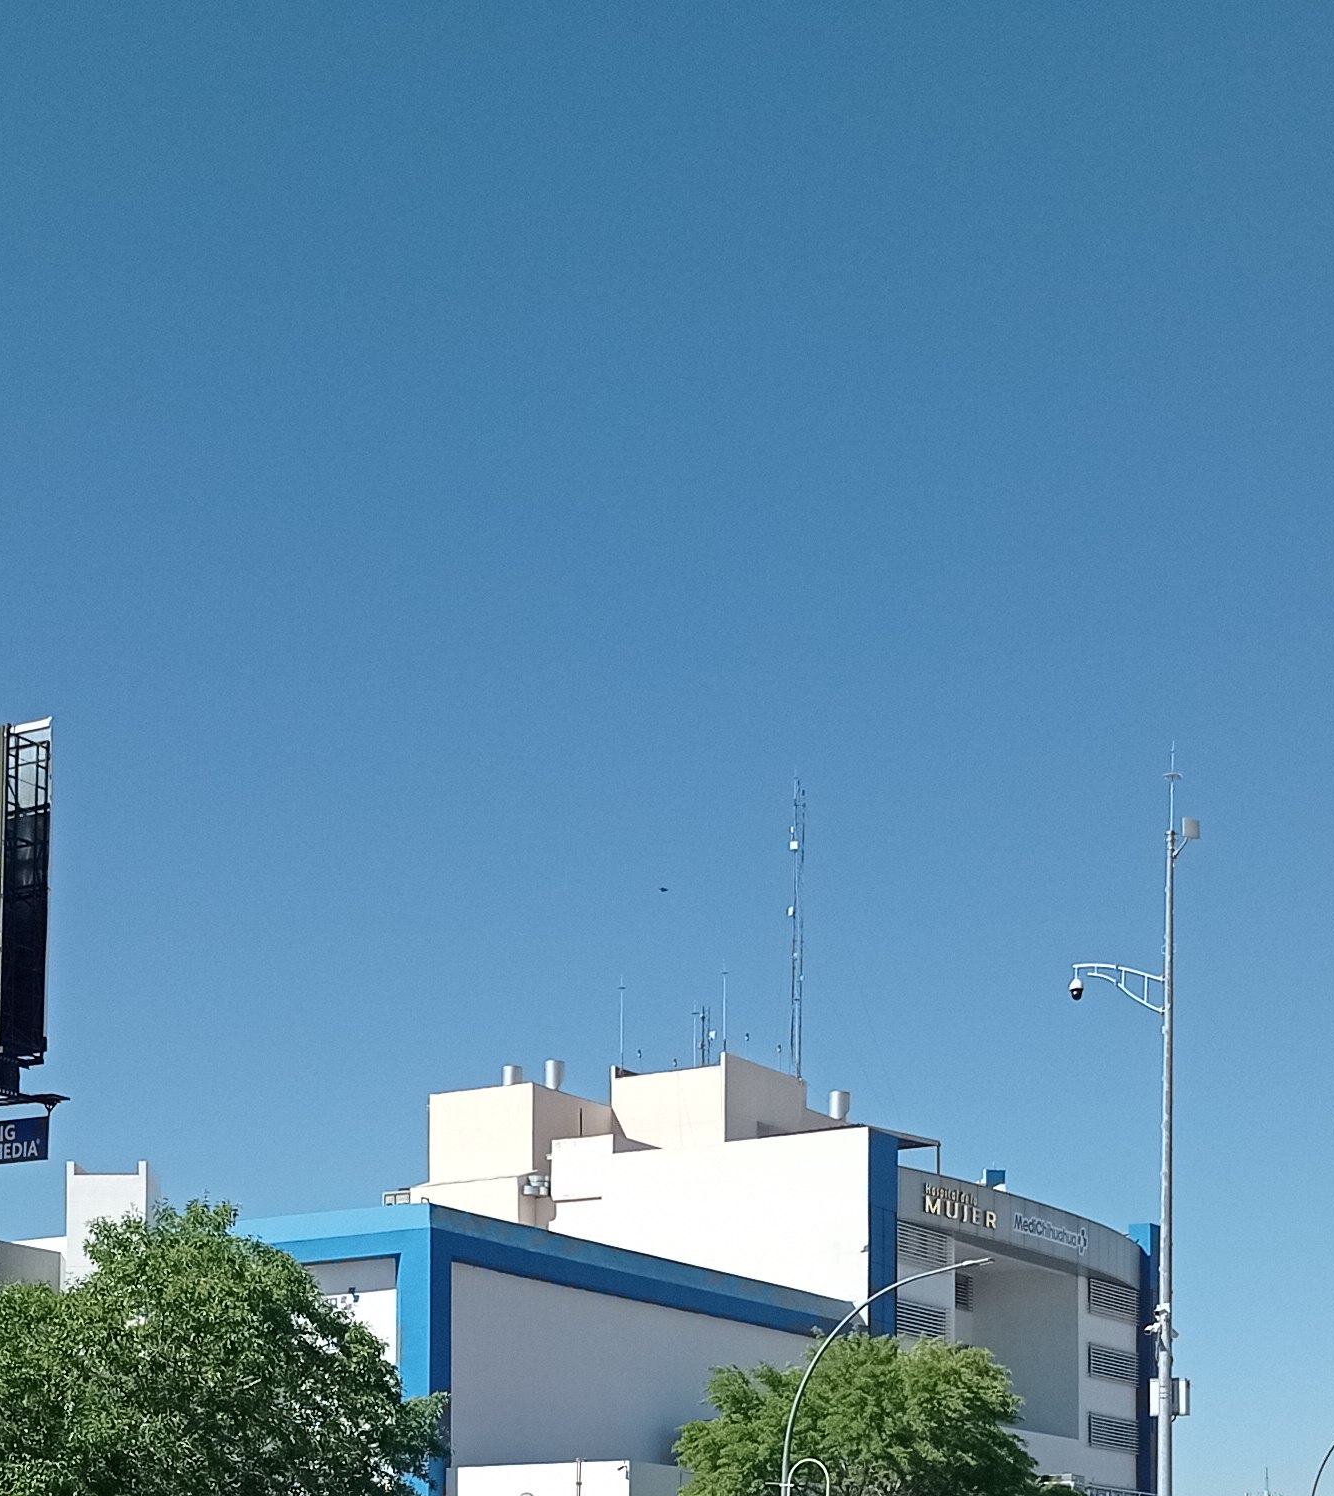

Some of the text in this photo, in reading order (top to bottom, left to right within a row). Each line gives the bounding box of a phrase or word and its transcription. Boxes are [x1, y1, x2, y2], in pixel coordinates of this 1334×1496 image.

[925, 1182, 960, 1202] Hospital
[925, 1195, 997, 1230] MUJER
[1014, 1214, 1076, 1246] MediChihuahua
